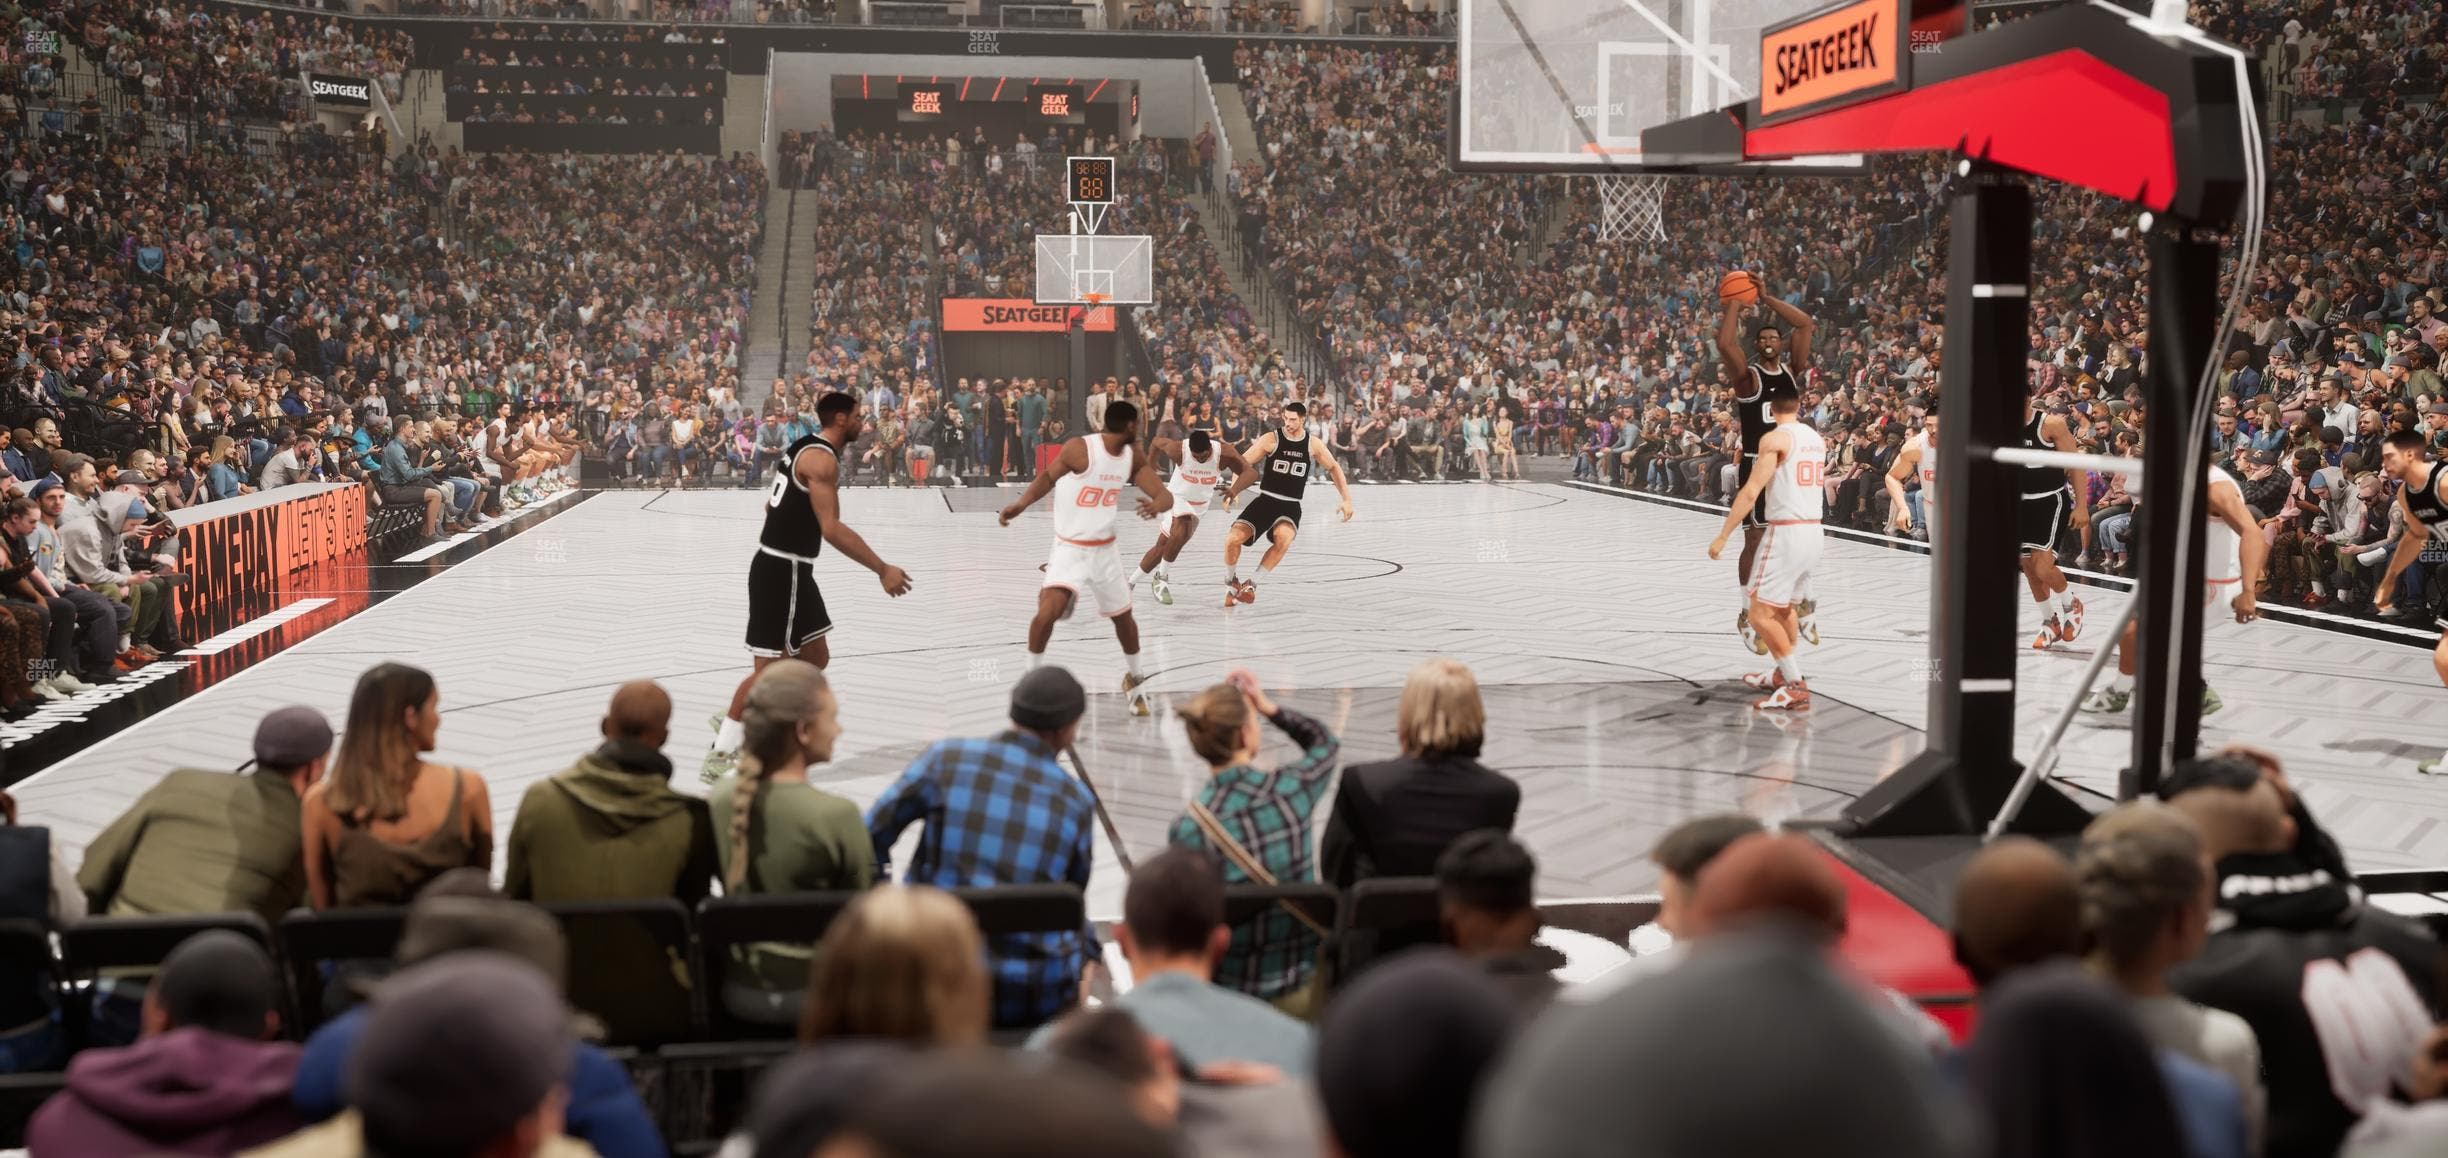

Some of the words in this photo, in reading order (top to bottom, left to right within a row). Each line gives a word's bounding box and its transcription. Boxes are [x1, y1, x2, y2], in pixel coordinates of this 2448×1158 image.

[1775, 12, 1879, 95] SEATGEEK
[312, 80, 368, 99] SEATGEEK
[913, 92, 941, 102] SEAT
[912, 102, 942, 114] GEEK
[1042, 94, 1068, 105] SEAT
[1041, 105, 1069, 116] GEEK
[1574, 102, 1625, 119] SEATEK
[1080, 177, 1104, 199] 88
[1272, 459, 1307, 477] 00
[178, 504, 280, 611] GAMEDAY
[286, 490, 336, 575] LET'S
[342, 484, 368, 553] GO!
